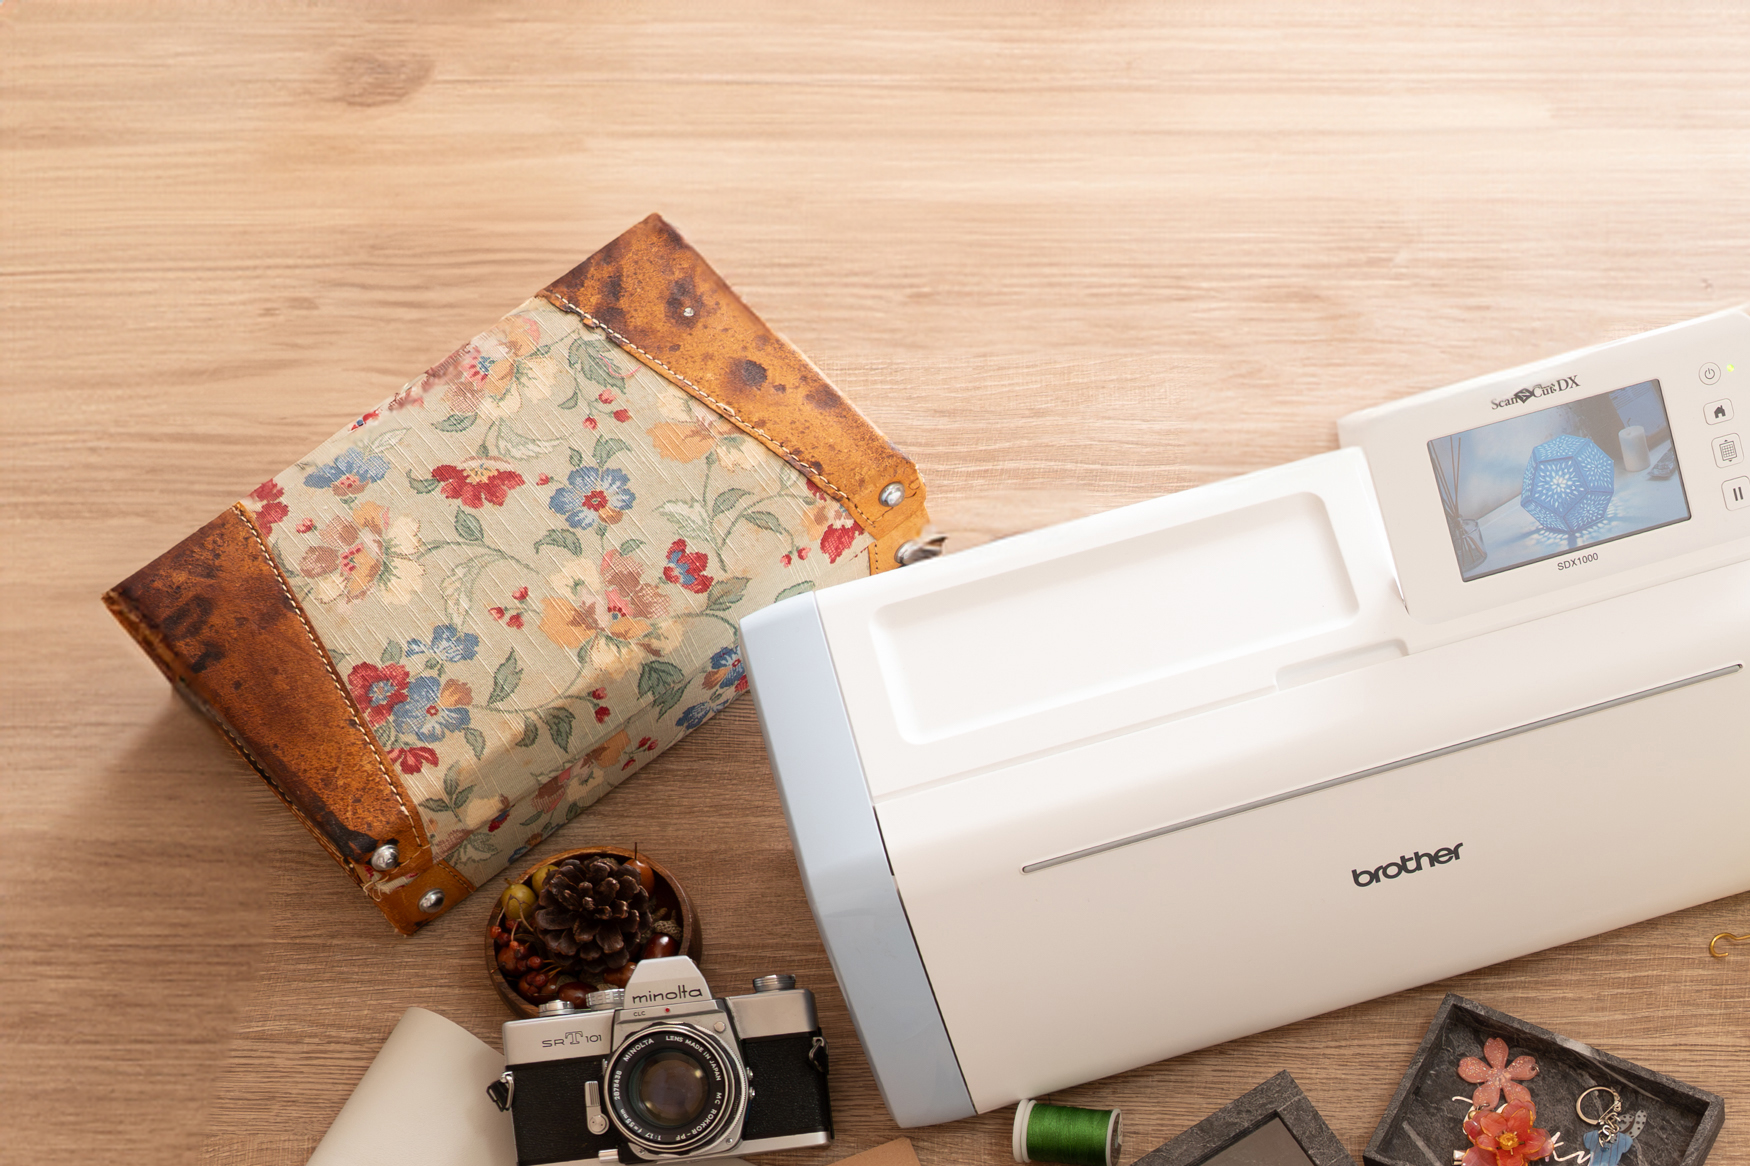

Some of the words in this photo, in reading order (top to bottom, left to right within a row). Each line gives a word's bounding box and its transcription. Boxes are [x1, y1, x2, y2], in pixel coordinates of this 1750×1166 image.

[1557, 552, 1598, 570] SDX1000
[1351, 842, 1463, 887] brother
[632, 985, 702, 1004] minolta
[665, 1035, 683, 1043] LENS
[684, 1039, 704, 1053] MADE
[623, 1038, 654, 1062] MINOLTA
[703, 1051, 711, 1060] IN
[709, 1060, 721, 1081] JAPAN
[714, 1092, 722, 1105] MC
